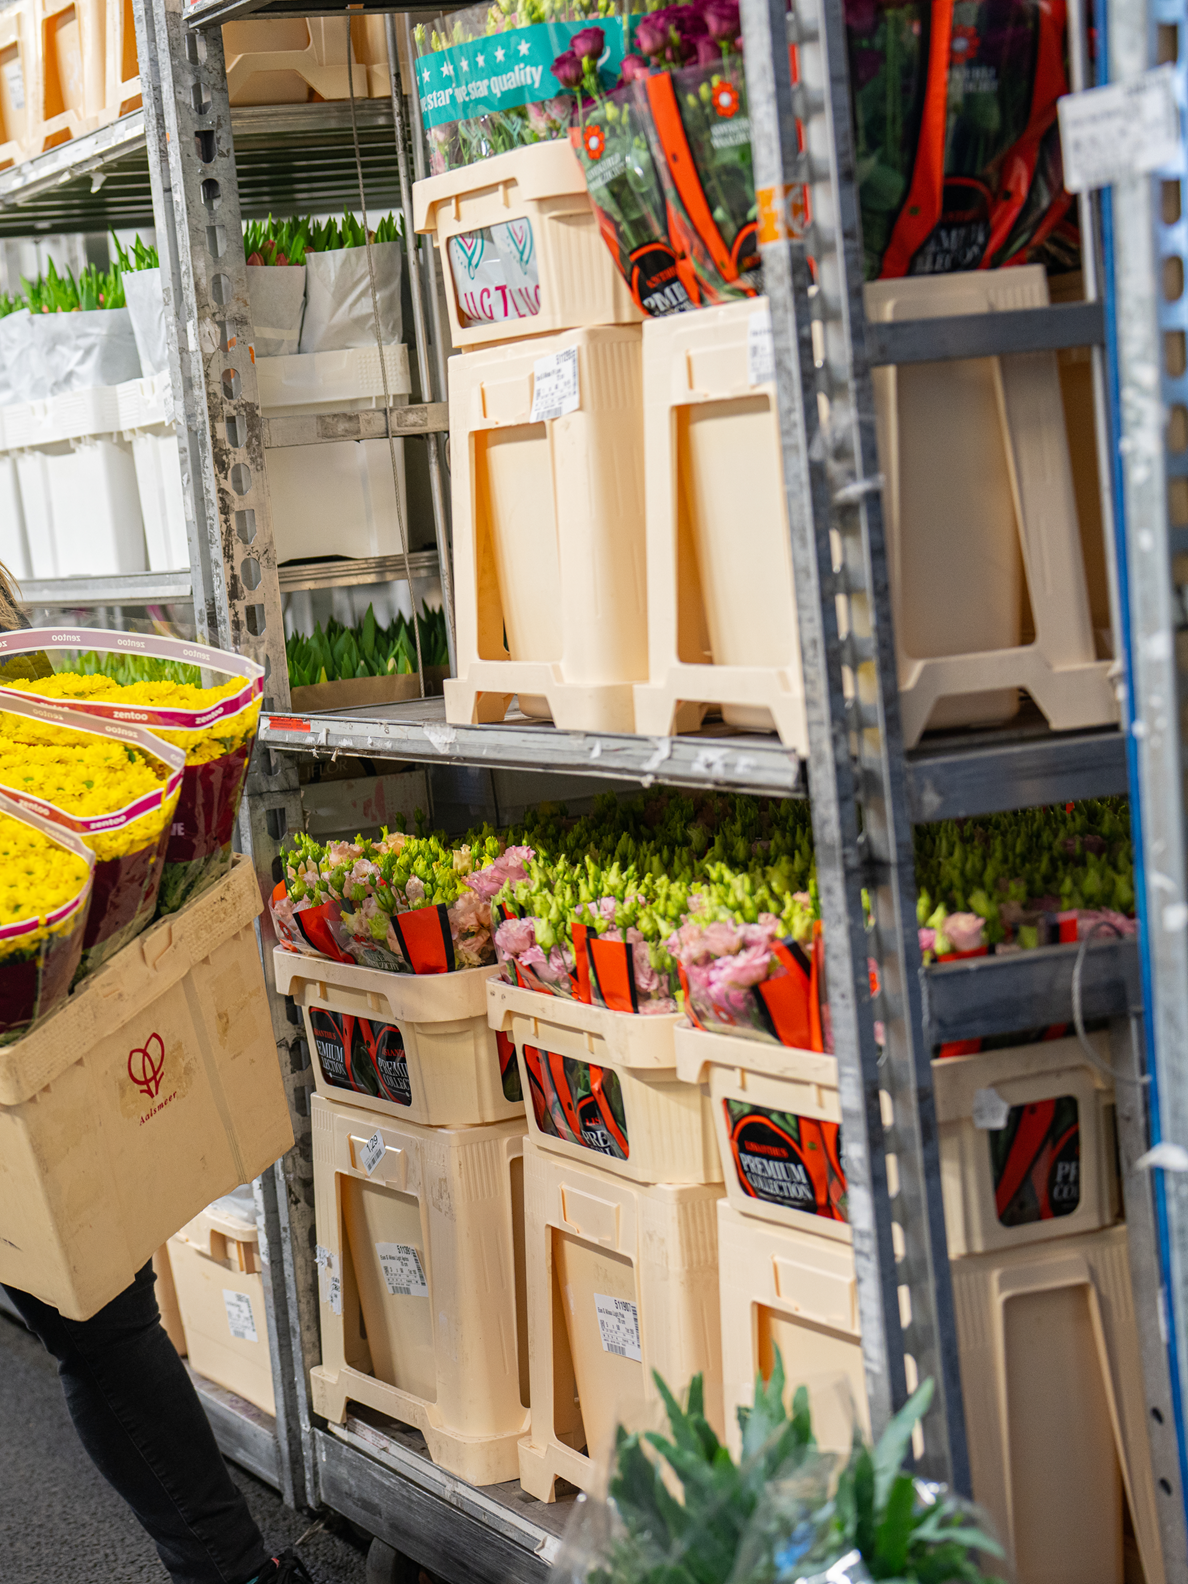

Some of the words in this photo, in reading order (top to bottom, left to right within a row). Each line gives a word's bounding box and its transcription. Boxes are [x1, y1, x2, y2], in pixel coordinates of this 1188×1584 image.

[468, 79, 490, 101] star
[490, 62, 544, 98] quality
[464, 284, 509, 321] UGT
[113, 709, 148, 721] zentoo
[89, 814, 126, 830] zentoo
[316, 1040, 344, 1063] EMIUM
[139, 1090, 178, 1127] Aalsmeer
[739, 1152, 809, 1184] PREMIUM
[746, 1171, 814, 1201] COLLECTION
